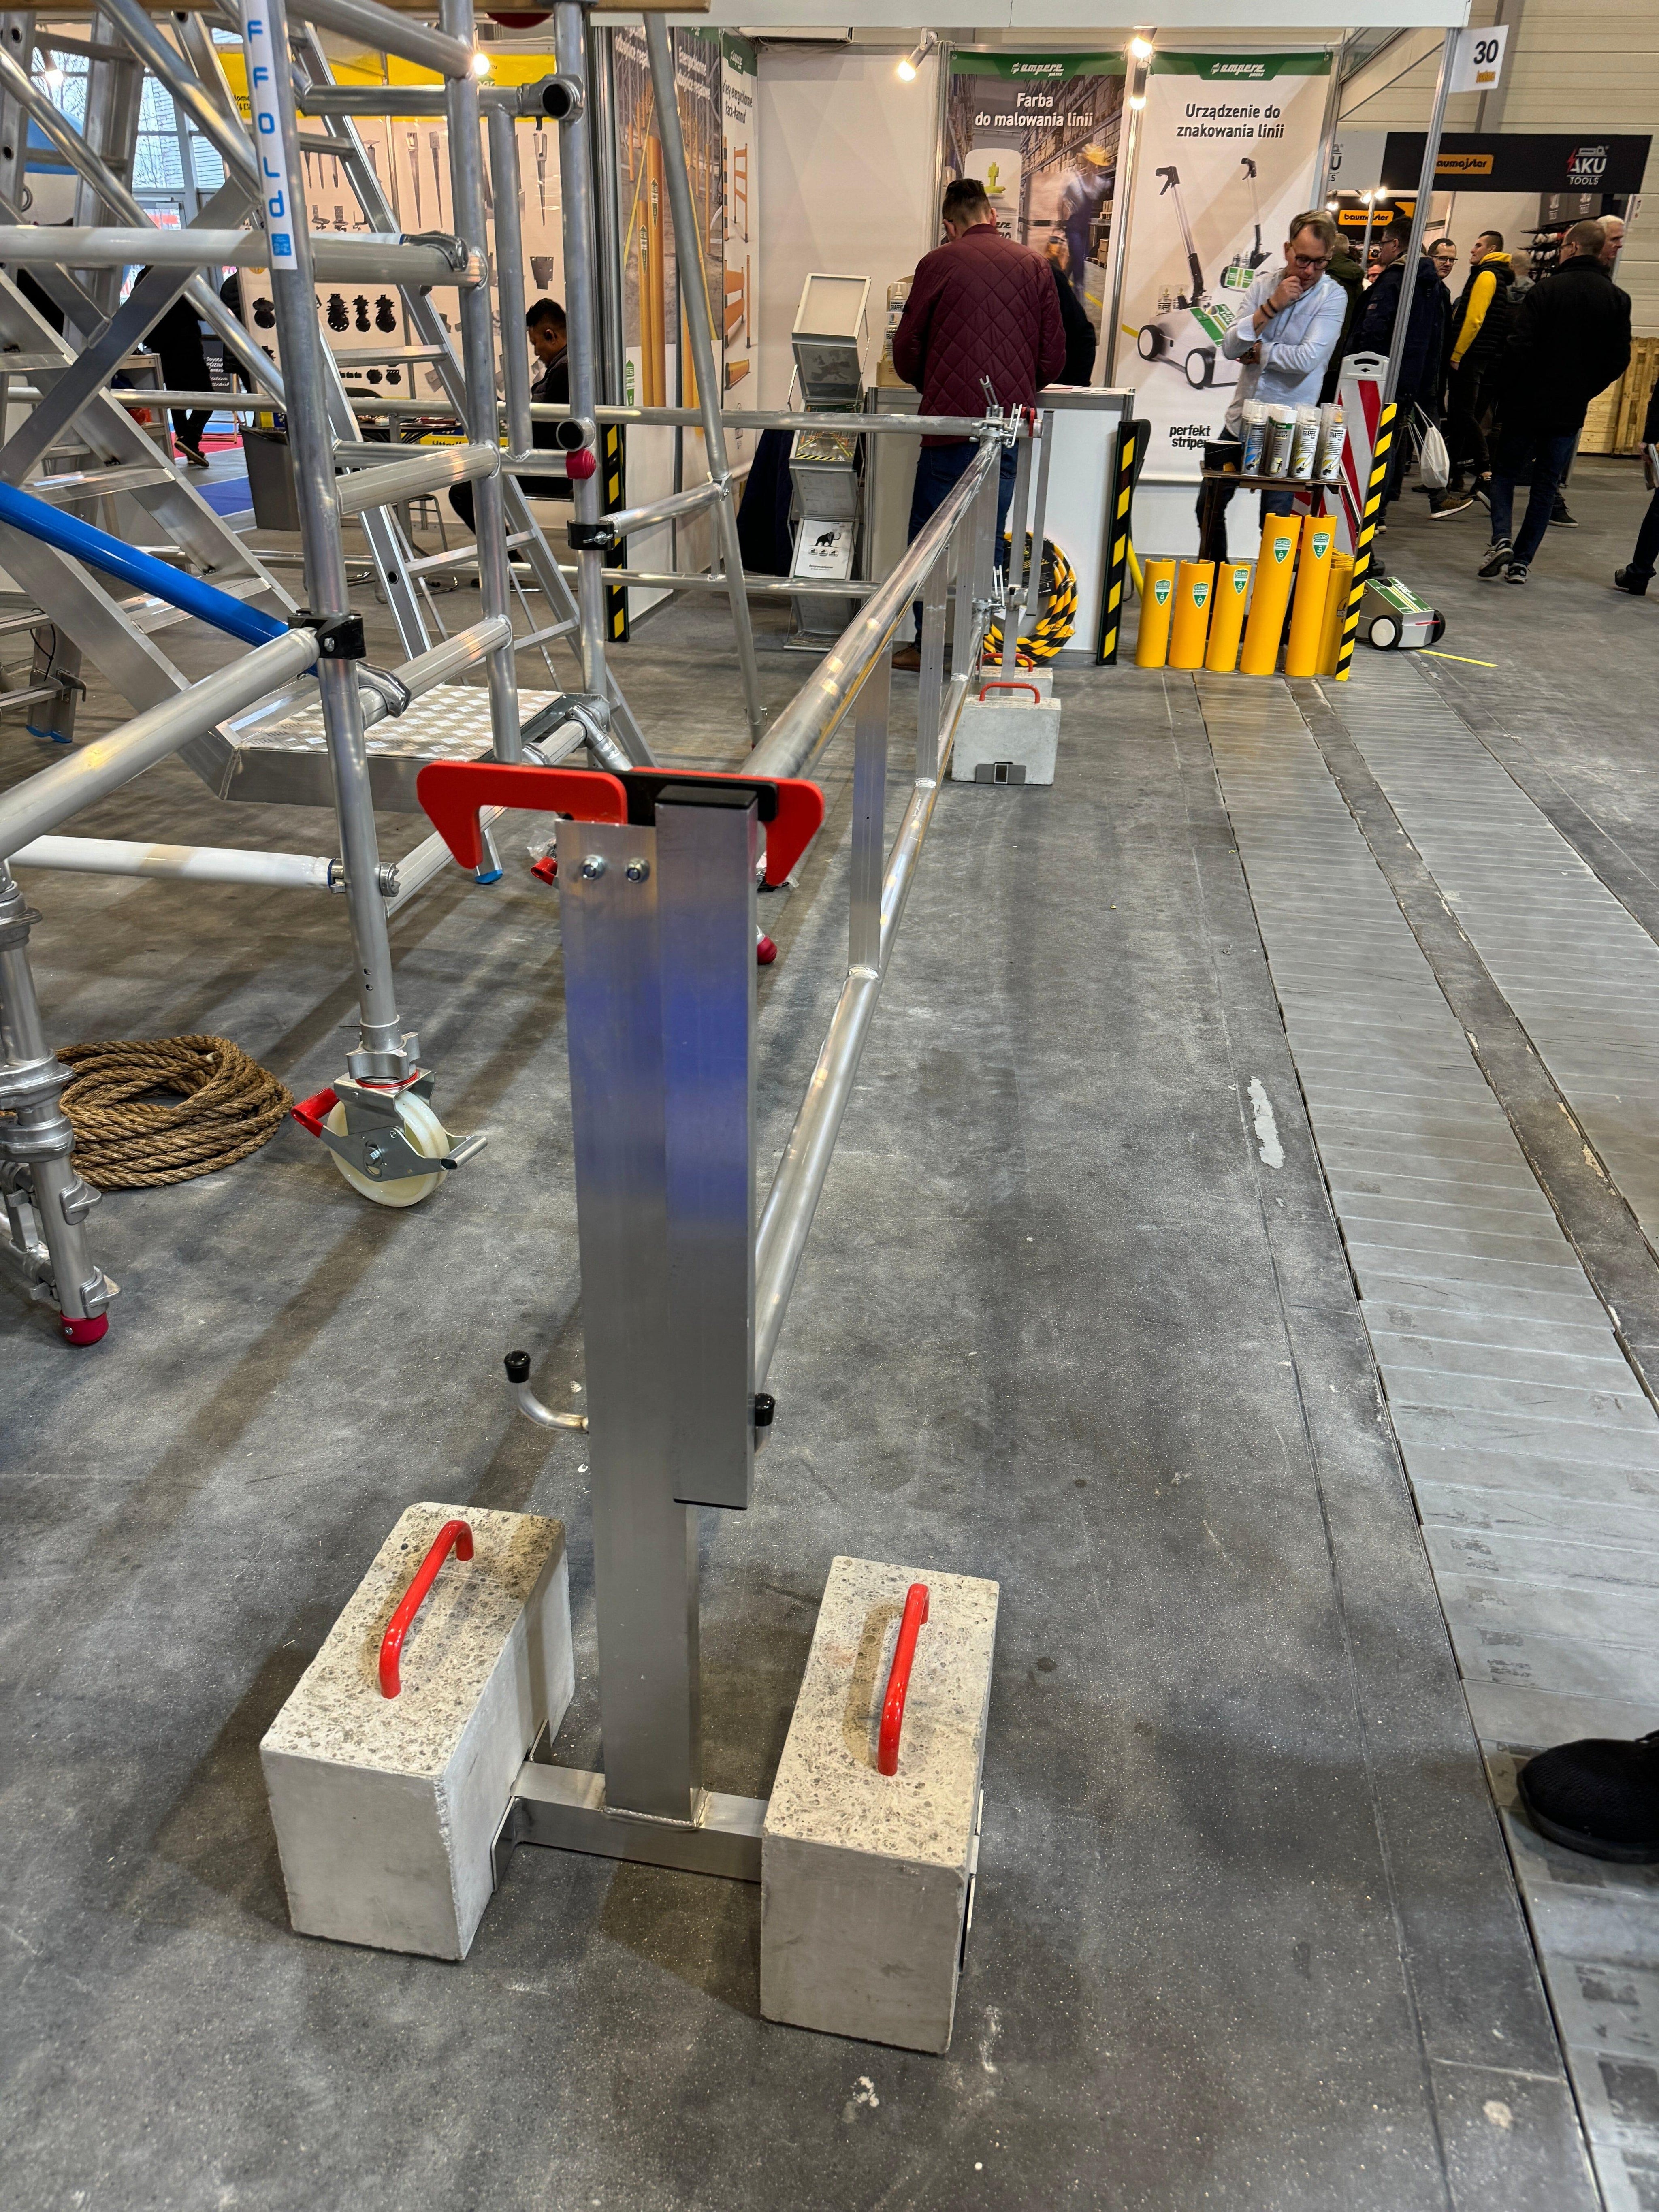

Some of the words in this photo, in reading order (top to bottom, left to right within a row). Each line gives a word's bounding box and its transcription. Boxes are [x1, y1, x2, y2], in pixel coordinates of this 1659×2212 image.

[1473, 39, 1499, 64] 30
[1020, 64, 1064, 75] ampere
[1220, 64, 1266, 75] ampere
[1017, 92, 1053, 107] Farba
[975, 111, 992, 126] do
[994, 112, 1064, 127] malowania
[1067, 112, 1093, 127] linii
[1186, 103, 1260, 121] Urządzenie
[1264, 104, 1281, 118] do
[1176, 123, 1254, 137] znakowania
[1258, 124, 1285, 138] linii
[1436, 158, 1487, 170] aumajster
[1567, 158, 1607, 174] AKU
[1569, 177, 1599, 185] TOOLS
[1169, 424, 1211, 437] perfekt
